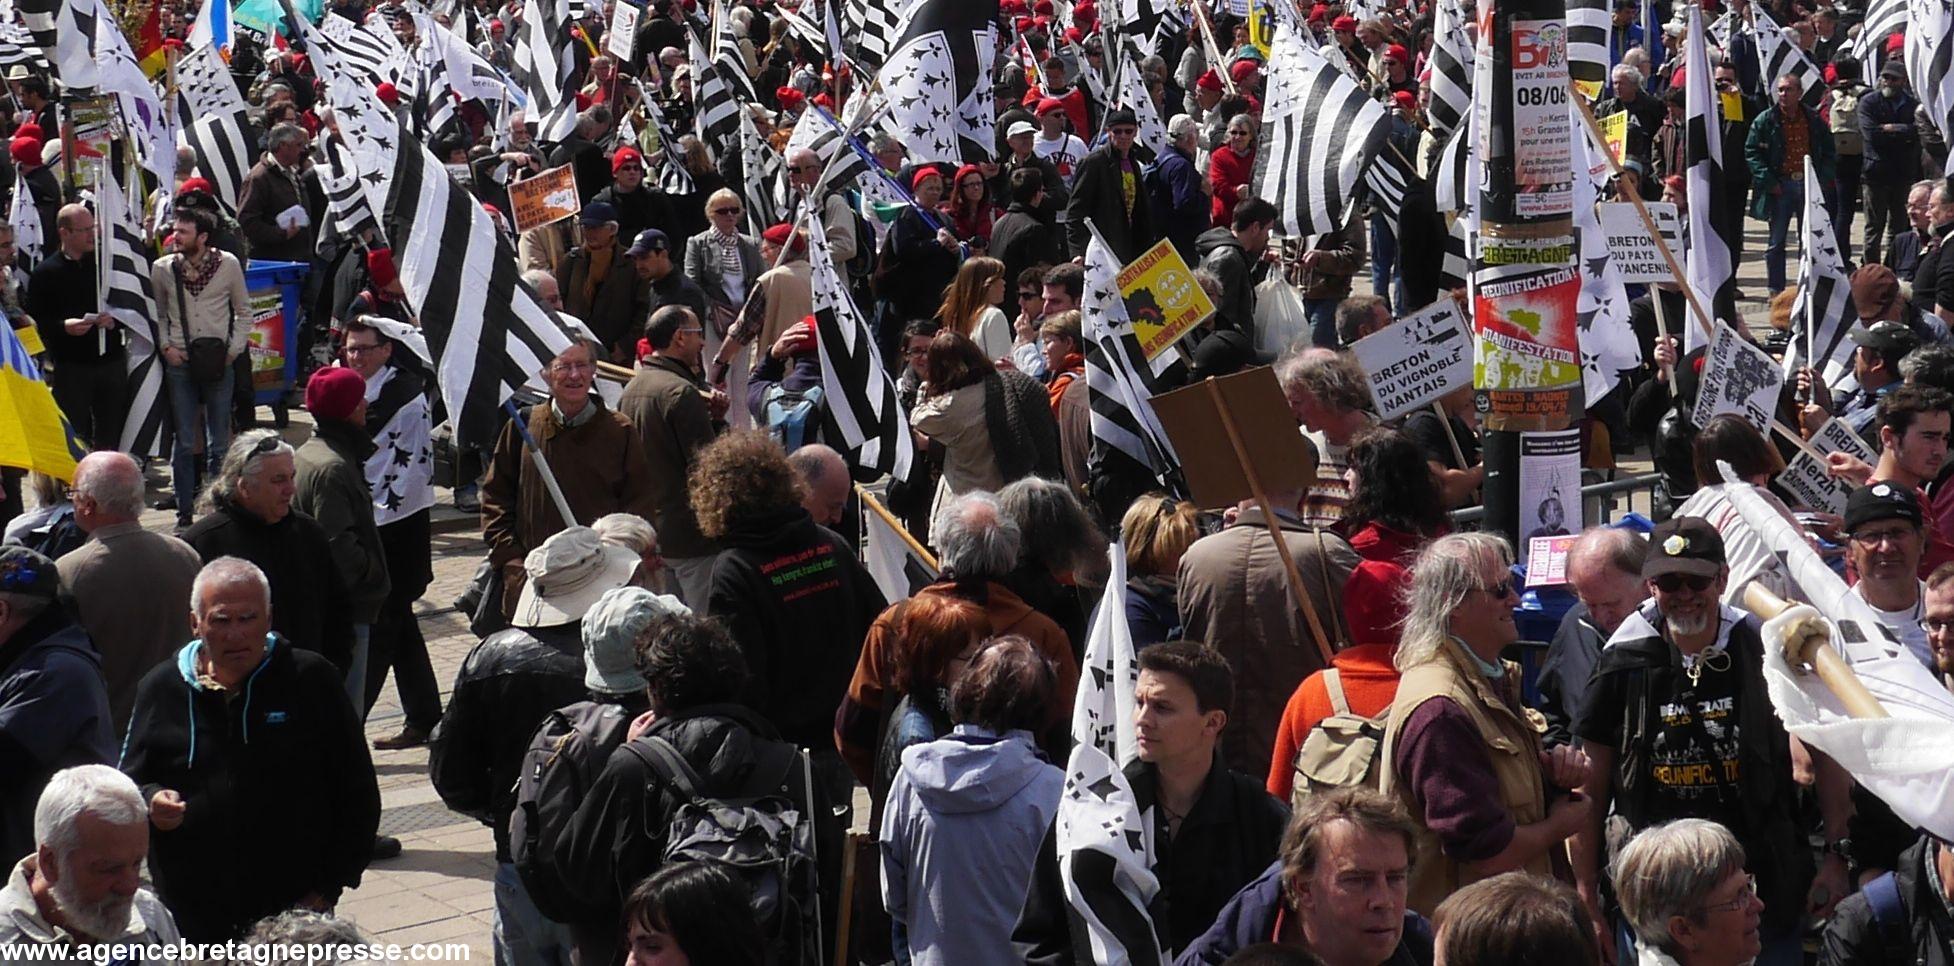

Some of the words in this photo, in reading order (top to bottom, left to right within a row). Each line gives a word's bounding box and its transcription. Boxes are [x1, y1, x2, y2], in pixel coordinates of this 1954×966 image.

[1517, 85, 1567, 106] 08/06
[1520, 138, 1539, 147] pour
[1537, 125, 1562, 135] Grande
[1608, 236, 1655, 247] BRETON
[1627, 251, 1655, 260] PAYS
[1483, 326, 1574, 364] MANIFESTATION
[1371, 349, 1431, 385] BRETON
[1377, 382, 1396, 399] DU
[1397, 352, 1462, 388] VIGNOBLE
[1383, 375, 1448, 413] NANTAIS
[1796, 451, 1836, 496] Nerzh
